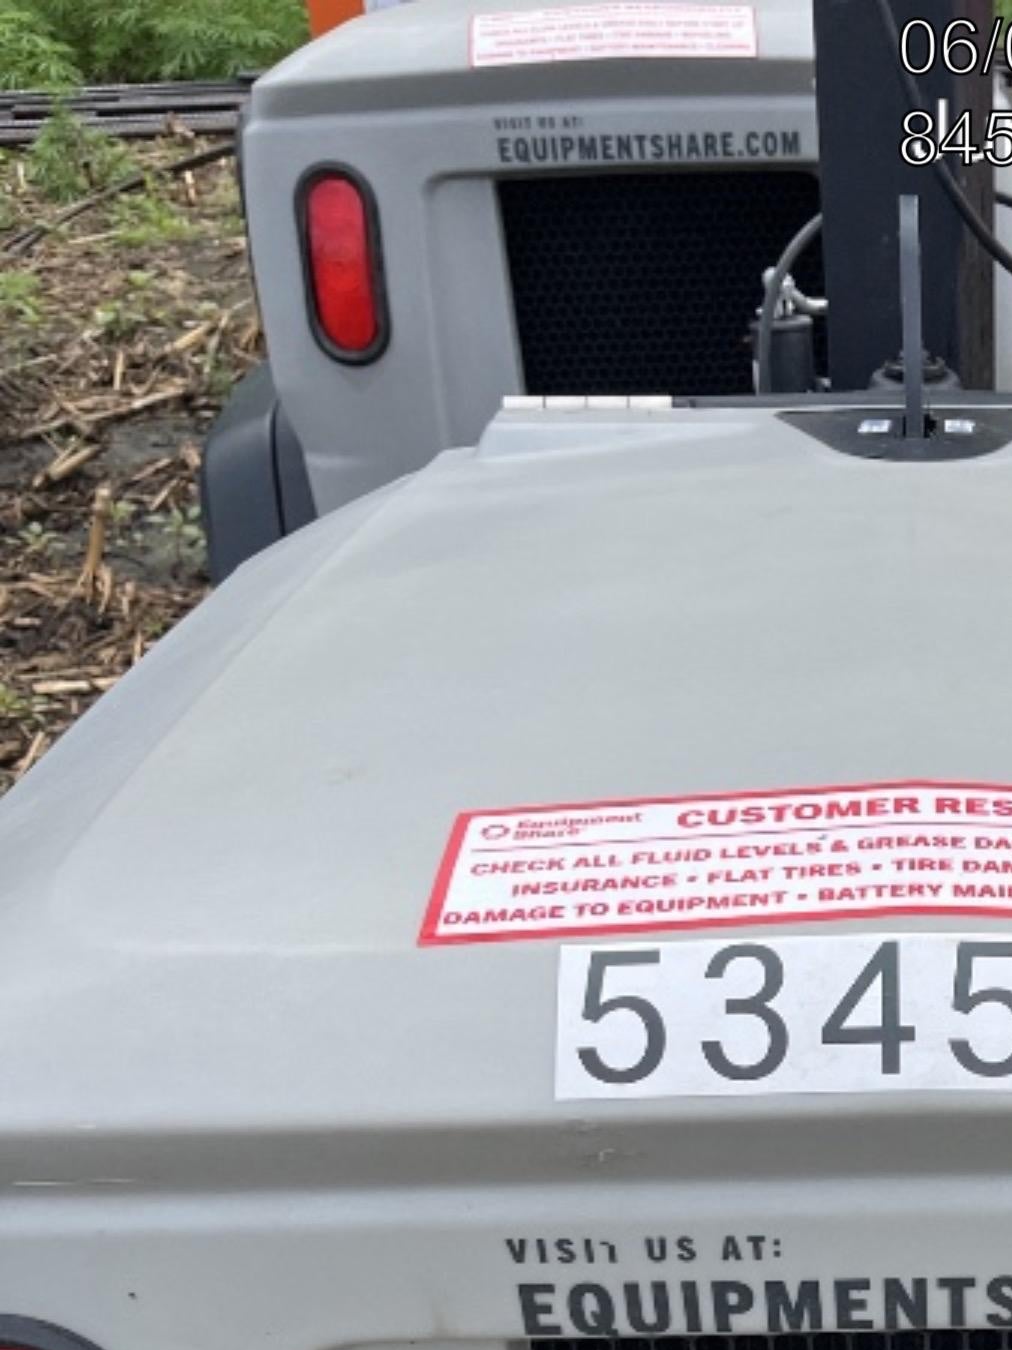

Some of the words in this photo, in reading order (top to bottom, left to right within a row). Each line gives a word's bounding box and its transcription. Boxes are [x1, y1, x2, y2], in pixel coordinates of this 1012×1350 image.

[497, 131, 800, 163] EQUIPMENTSHARE.COM
[676, 797, 921, 829] CUSTOMER
[470, 856, 566, 876] CHECK
[573, 854, 621, 869] ALL
[632, 847, 712, 865] FLUID
[719, 841, 823, 859] LEVELS
[830, 839, 849, 853] &
[857, 836, 967, 850] GREASE
[511, 873, 678, 897] INSURANCE
[707, 867, 774, 883] FLAT
[782, 863, 862, 880] TIRES
[891, 858, 954, 872] TIRE
[442, 905, 566, 925] DAMAGE
[575, 902, 610, 918] TO
[617, 890, 789, 915] EQUIPMENT
[818, 884, 943, 902] BATTERY
[644, 1236, 697, 1262] US
[721, 1235, 783, 1261] AT:
